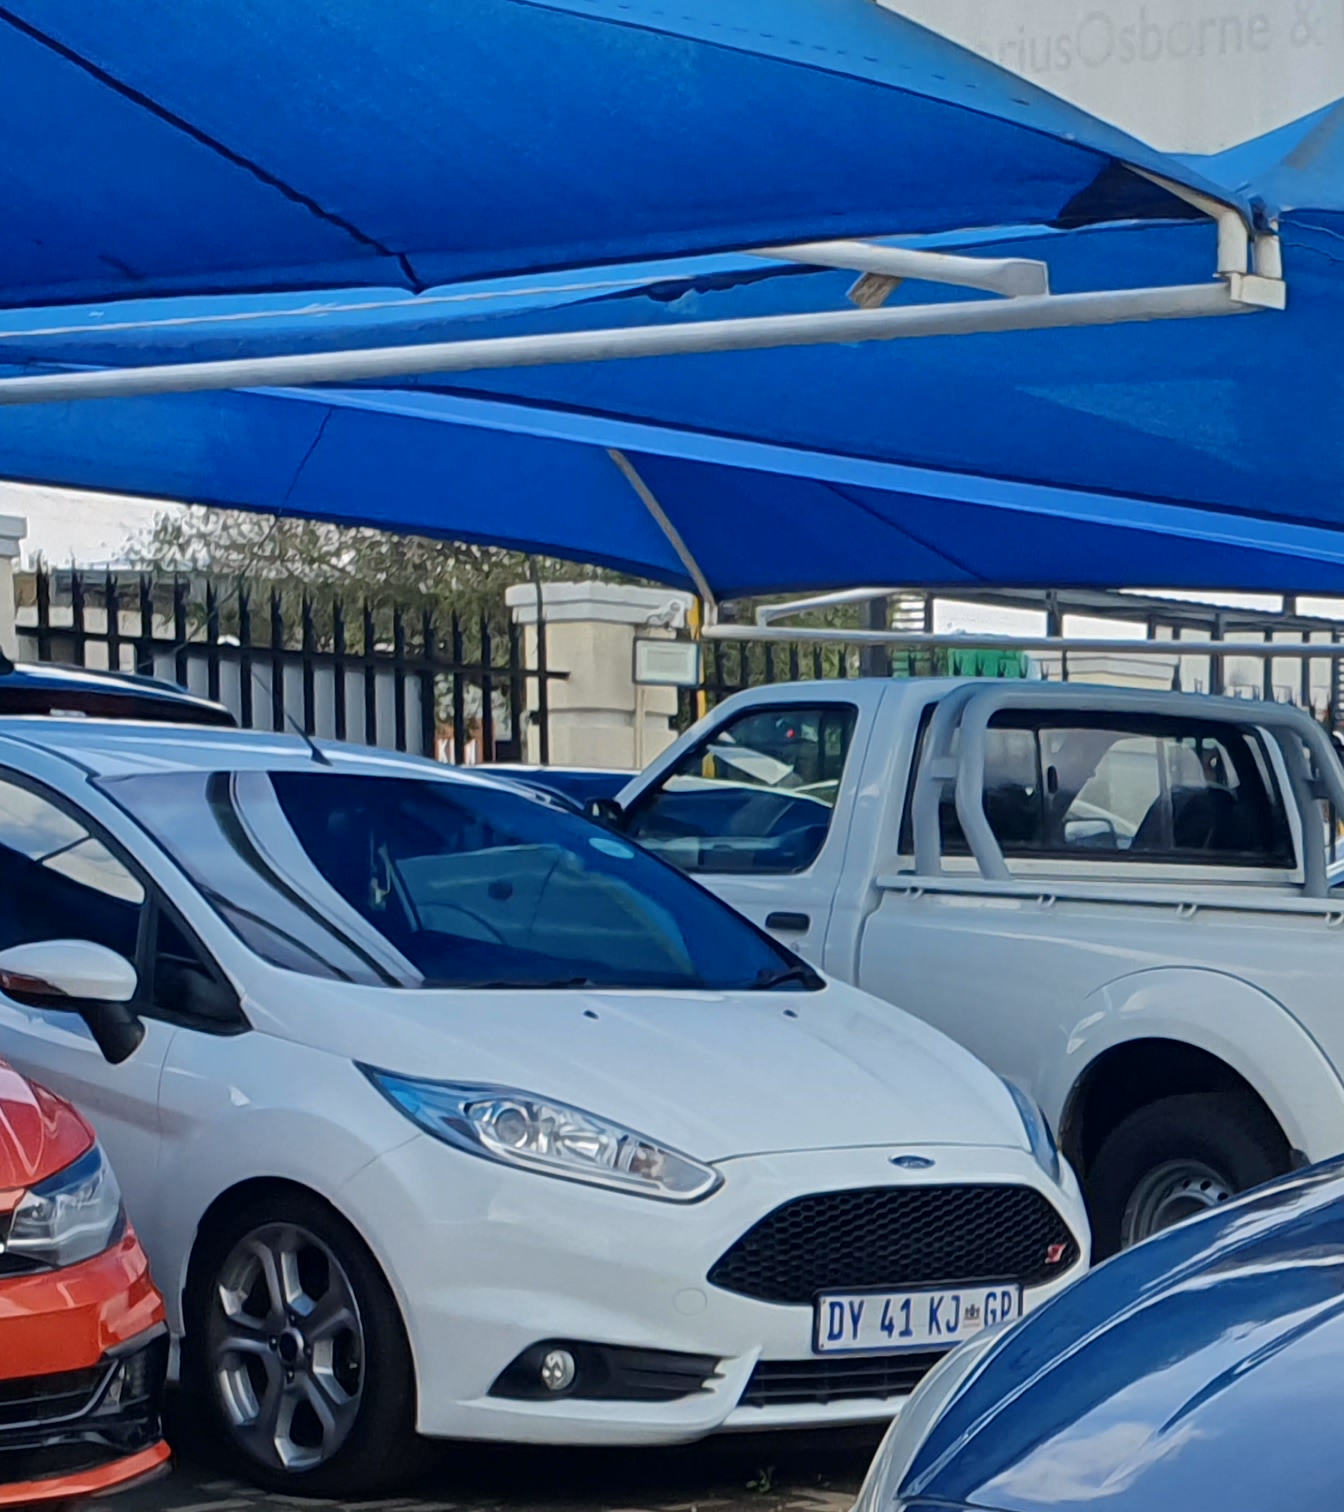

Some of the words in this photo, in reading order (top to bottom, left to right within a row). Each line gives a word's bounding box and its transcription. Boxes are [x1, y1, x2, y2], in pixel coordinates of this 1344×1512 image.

[826, 1300, 866, 1342] DY
[879, 1296, 914, 1339] 41
[927, 1294, 961, 1336] KJ
[983, 1289, 1013, 1328] GP
